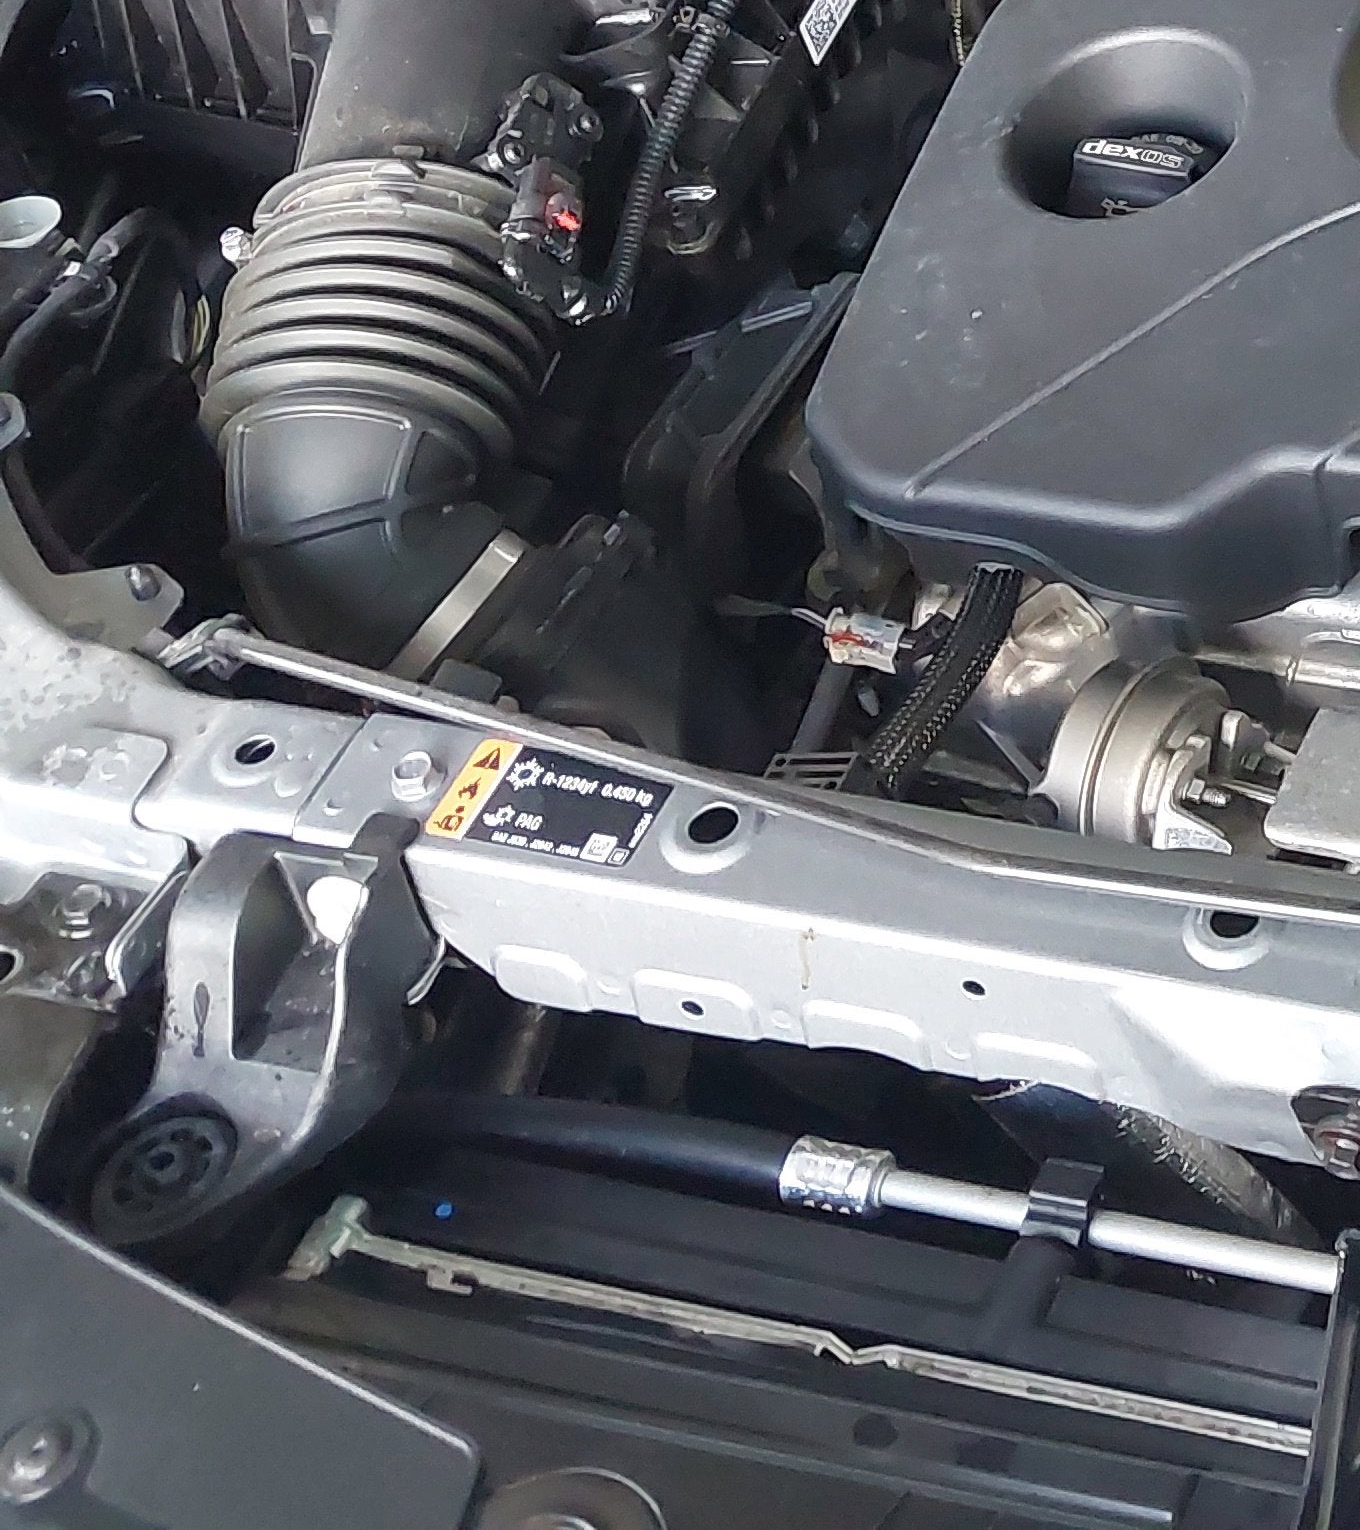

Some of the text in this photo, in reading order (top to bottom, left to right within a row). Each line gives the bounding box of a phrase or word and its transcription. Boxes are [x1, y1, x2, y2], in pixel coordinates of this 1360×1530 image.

[1082, 138, 1185, 169] dexos
[541, 770, 600, 795] R-1234yf
[635, 788, 654, 807] kg
[514, 811, 544, 831] PAG
